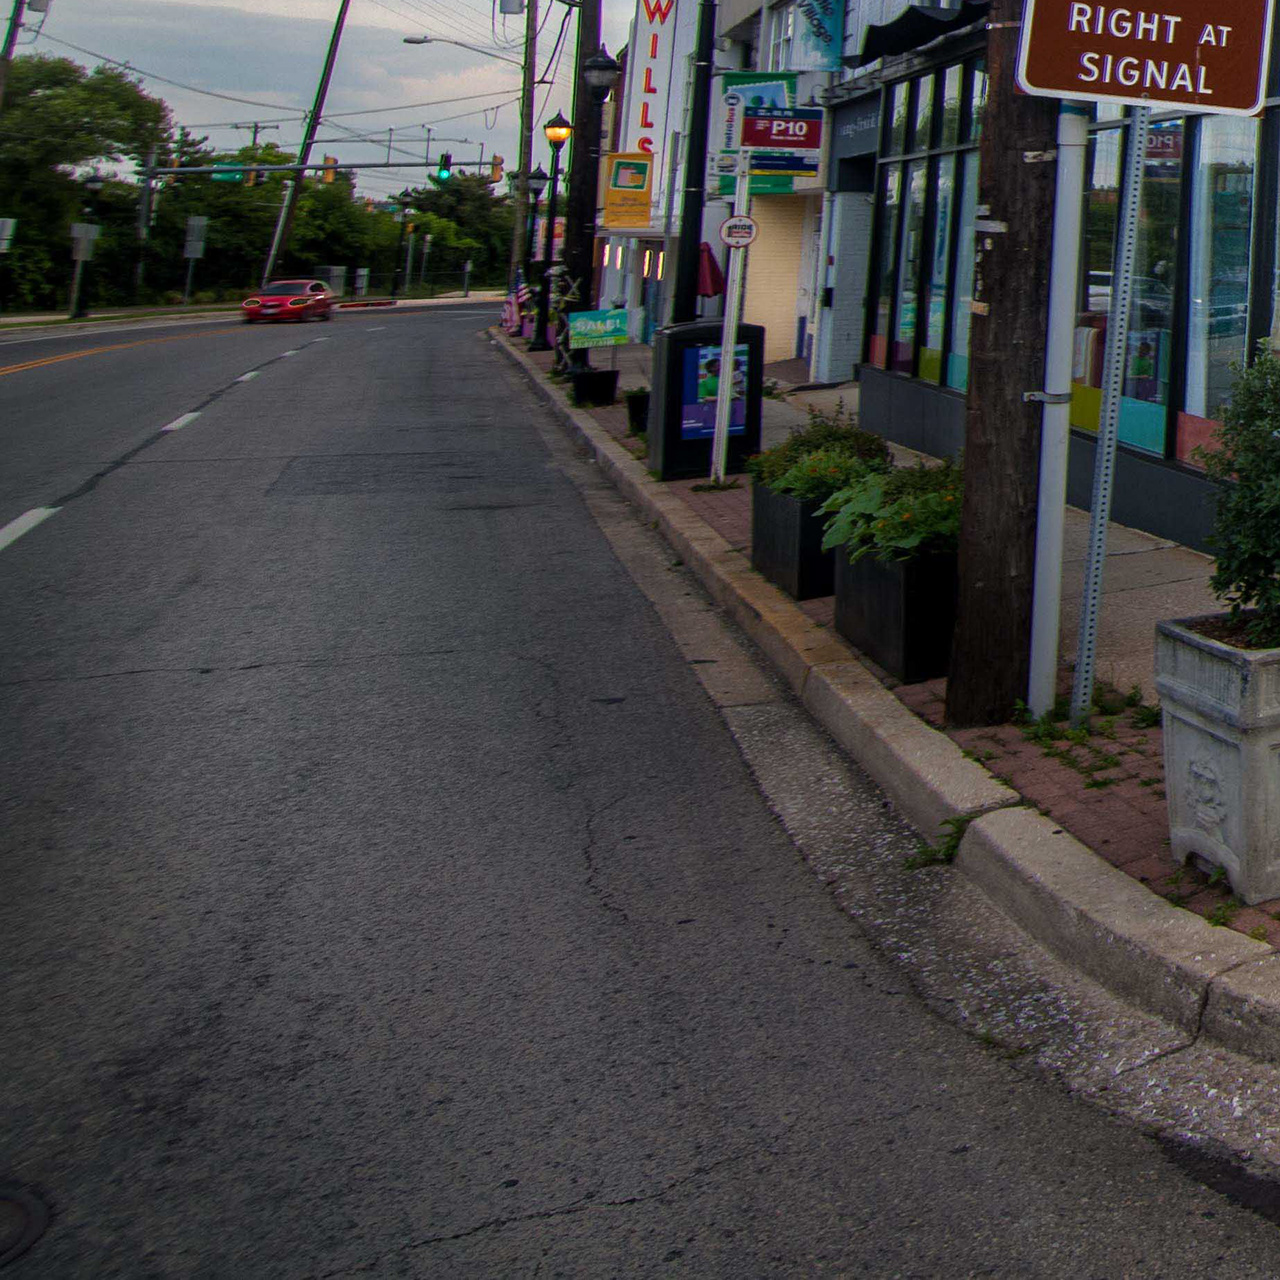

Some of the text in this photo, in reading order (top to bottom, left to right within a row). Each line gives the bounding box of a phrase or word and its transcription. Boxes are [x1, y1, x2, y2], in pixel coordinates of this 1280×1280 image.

[1068, 1, 1232, 47] RIGHT AT
[1077, 52, 1213, 94] SIGNAL
[771, 120, 808, 136] P10
